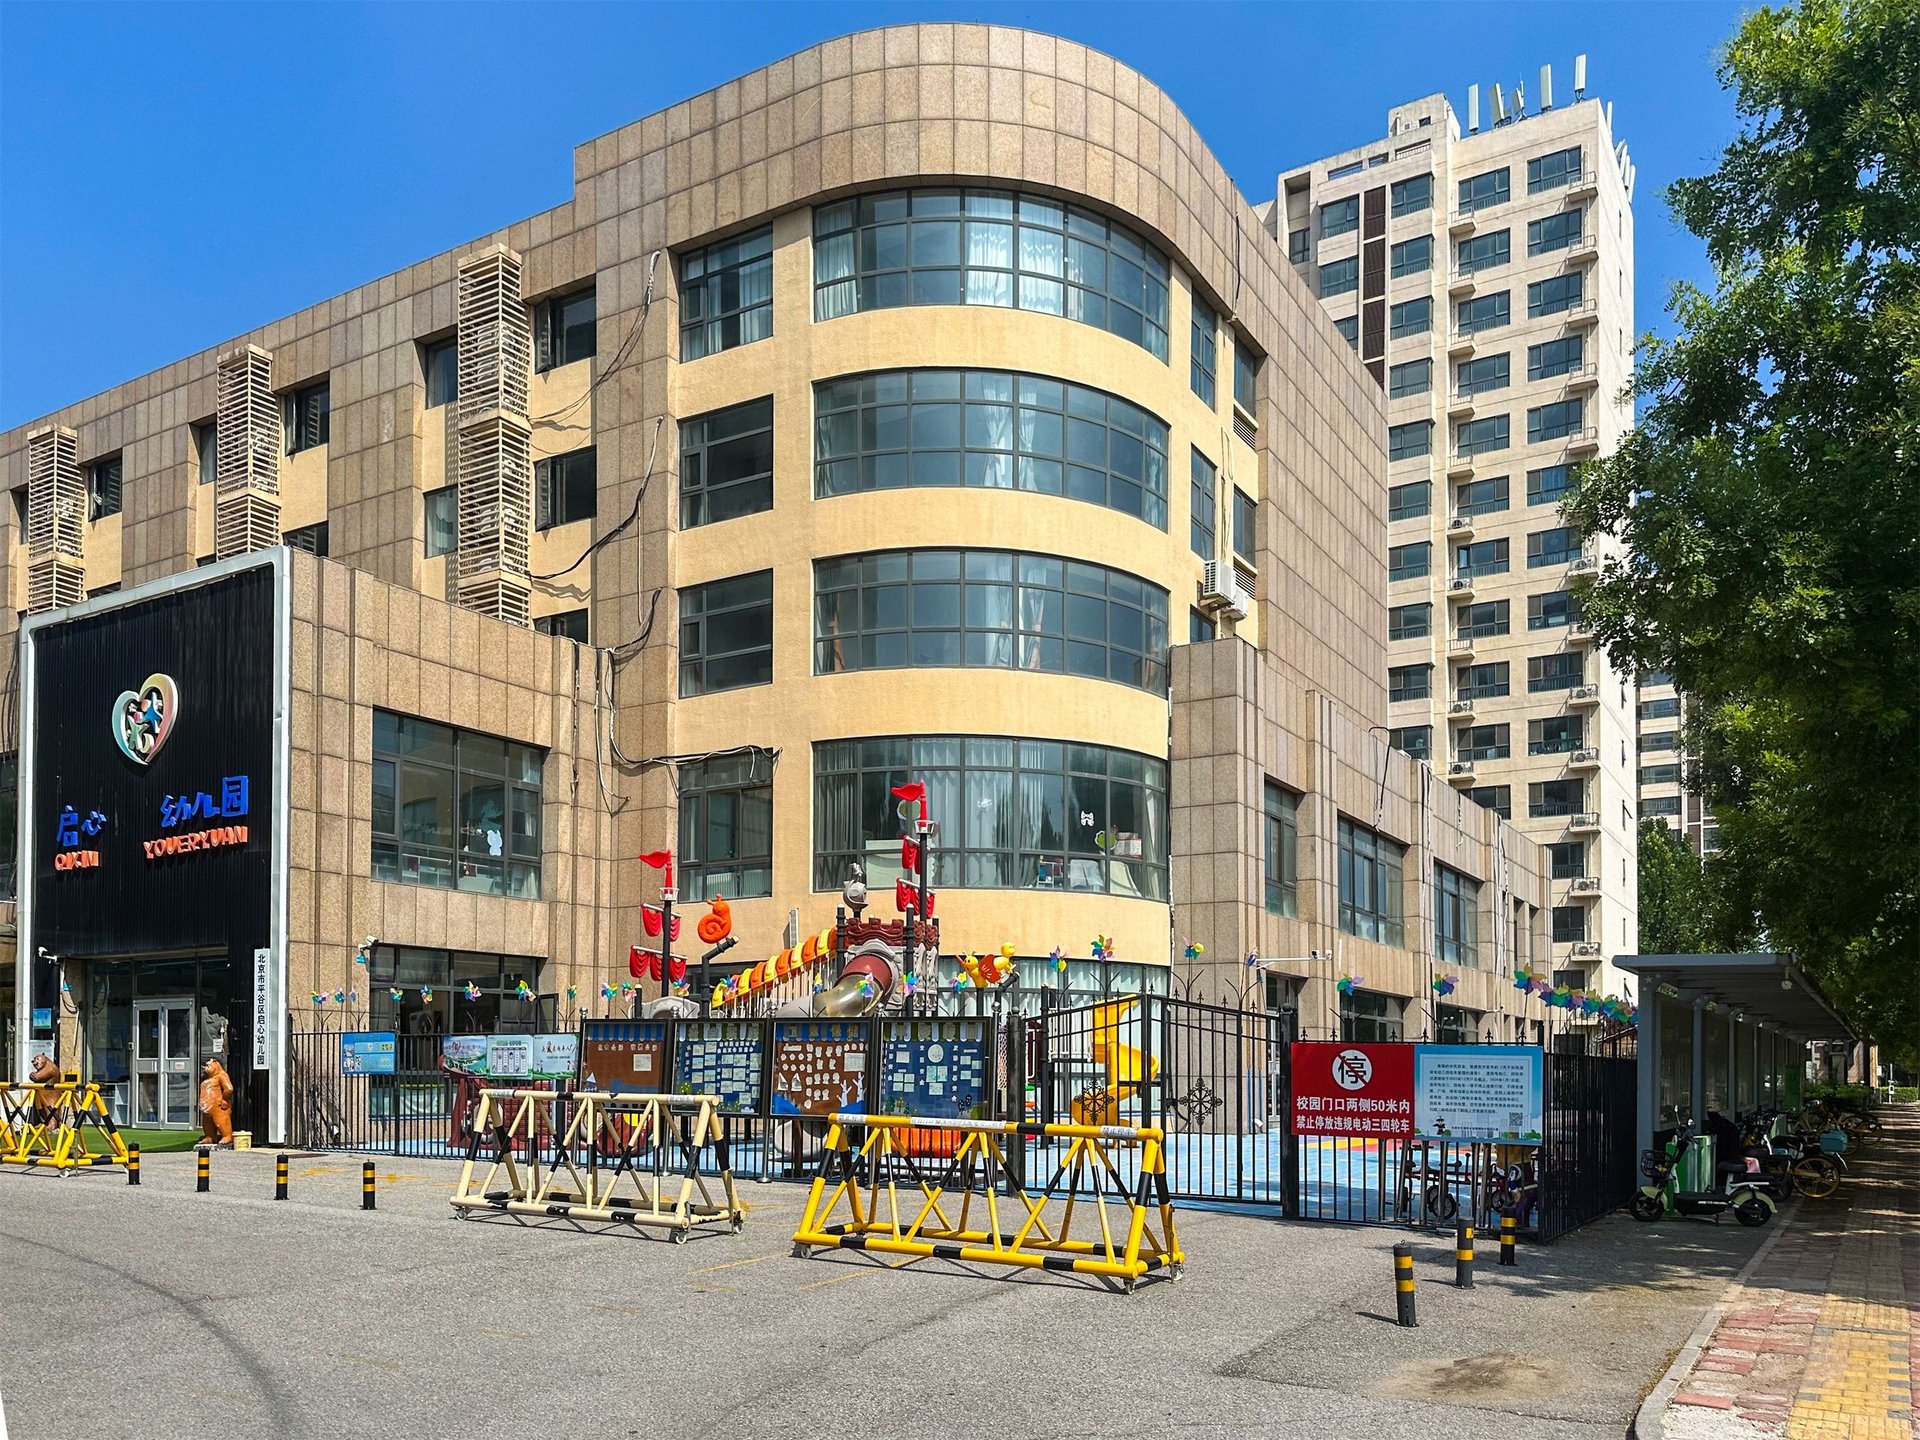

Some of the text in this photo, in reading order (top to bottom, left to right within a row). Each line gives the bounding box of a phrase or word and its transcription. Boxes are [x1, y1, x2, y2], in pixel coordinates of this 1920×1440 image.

[56, 775, 249, 847] 启心 幼儿园
[143, 825, 249, 859] YOUERYUAN
[256, 953, 267, 1066] 北京市平谷区启心幼儿园
[1296, 1095, 1410, 1114] 校园门口两侧50米内
[1296, 1114, 1410, 1133] 禁止停放违规电动三四轮车
